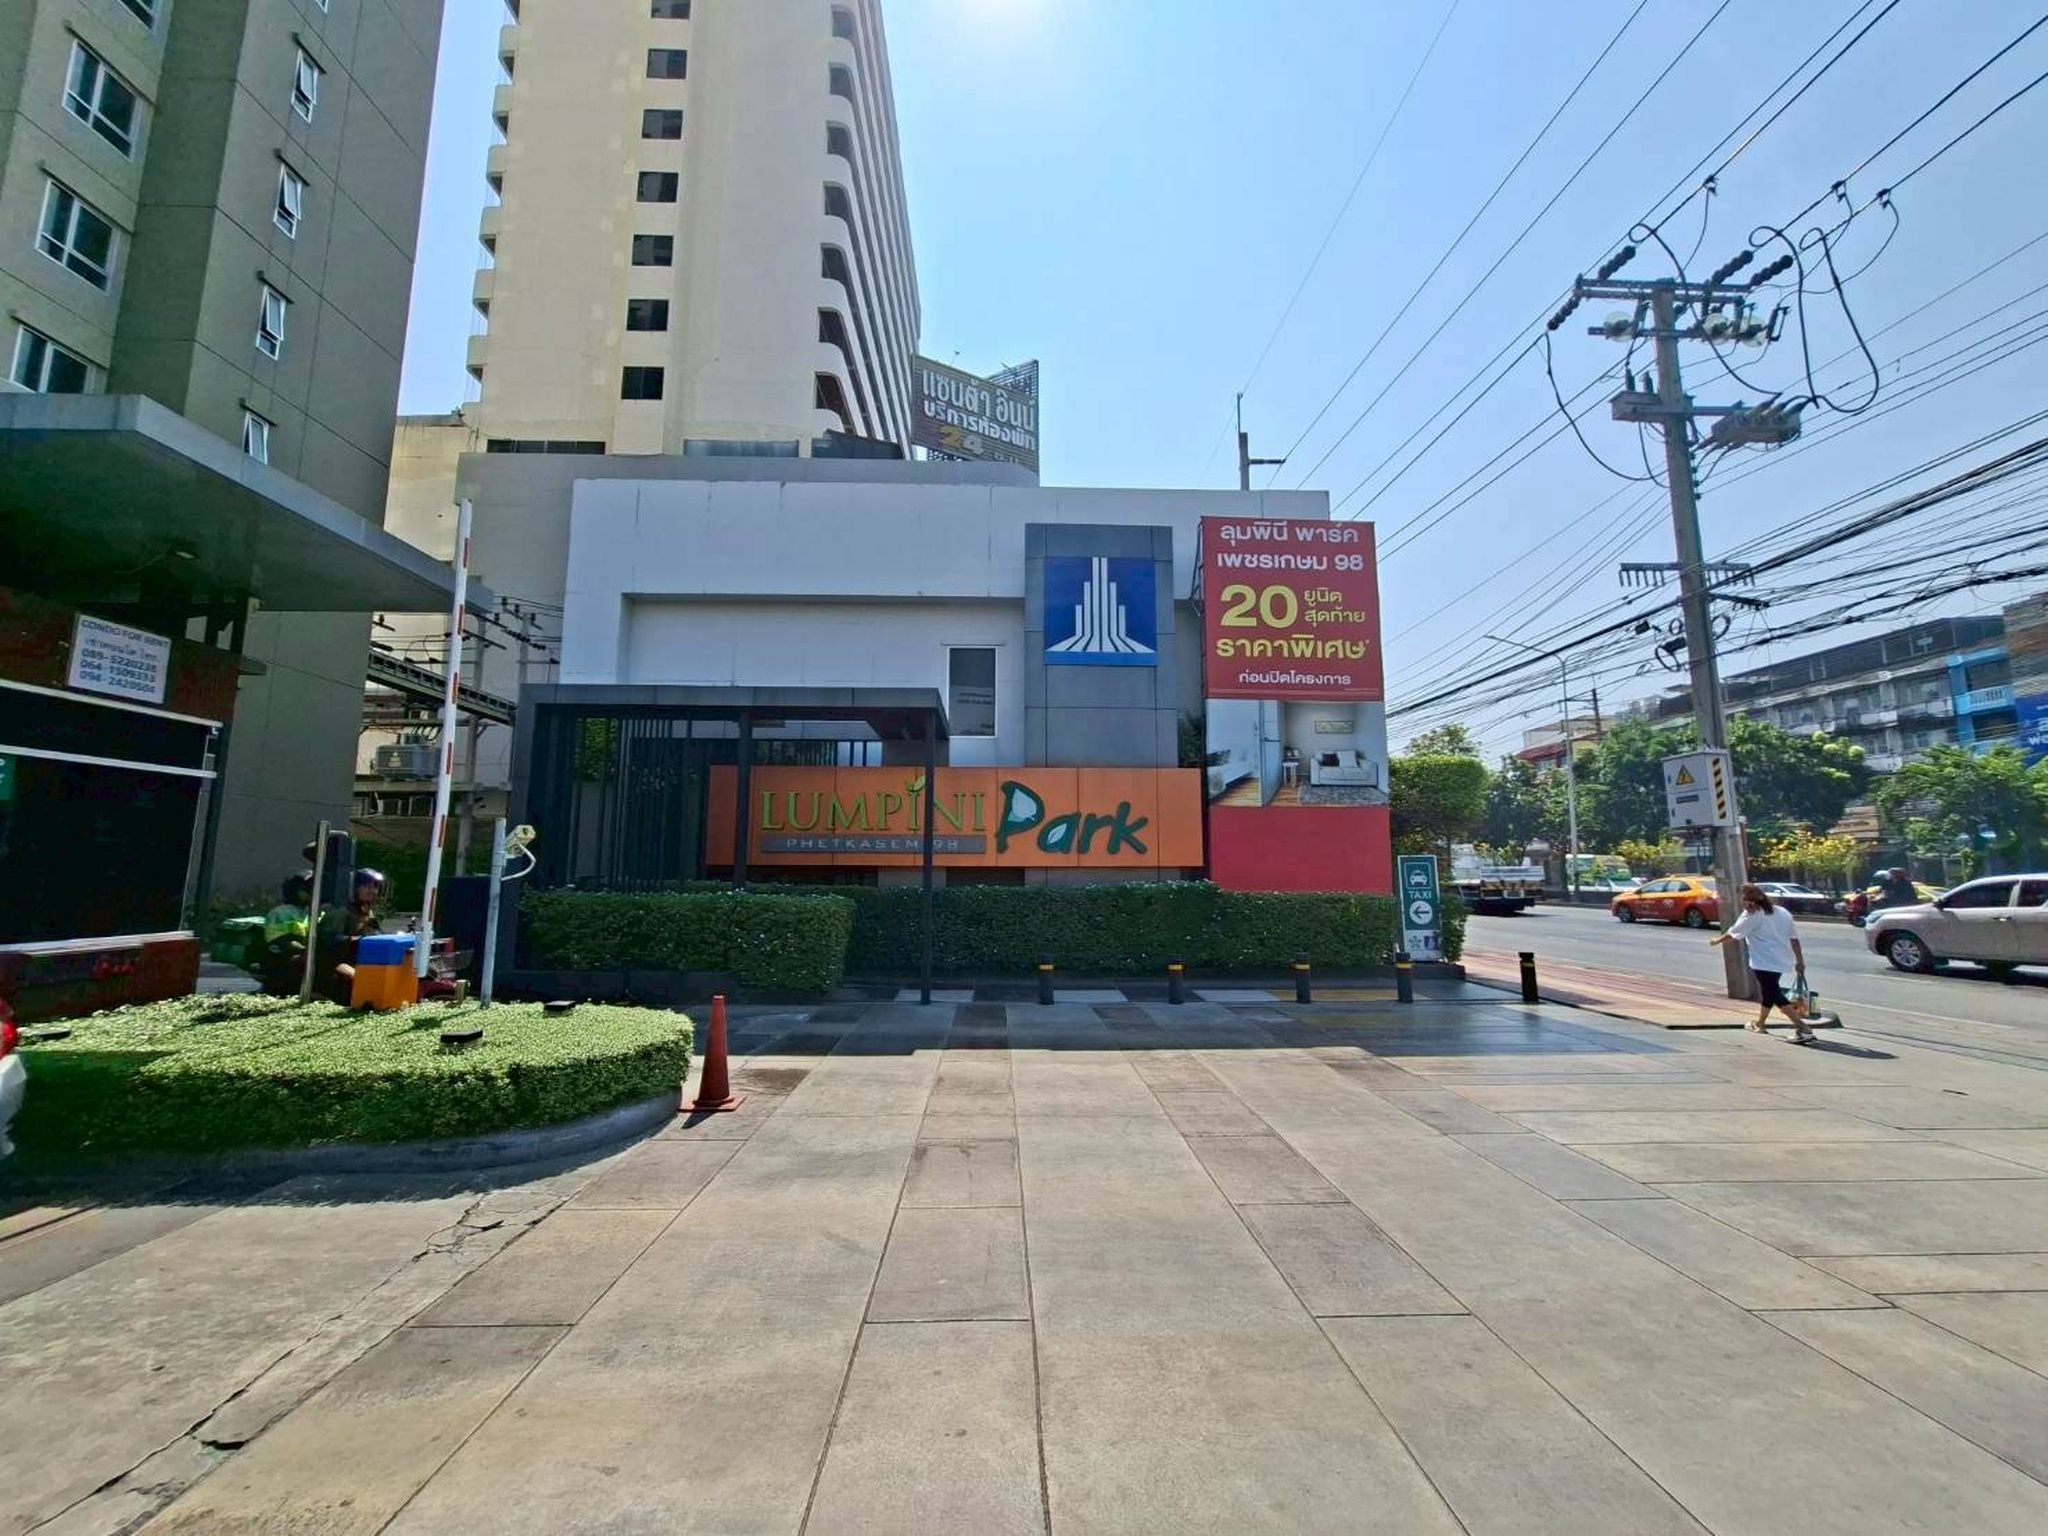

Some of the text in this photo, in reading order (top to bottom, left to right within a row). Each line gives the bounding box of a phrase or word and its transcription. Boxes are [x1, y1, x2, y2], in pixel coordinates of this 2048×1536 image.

[1220, 521, 1359, 546] ลุมพินี พาร์ค
[1217, 553, 1364, 571] เพชรเกษม 98
[1220, 584, 1298, 629] 20
[1304, 588, 1342, 607] ยูนิต
[1304, 605, 1365, 627] สุดท้าย
[1239, 669, 1351, 685] ก่อนปิดโครงการ
[760, 780, 1149, 855] LUMPINI Park
[786, 838, 960, 850] PHETKASEM 98
[1408, 890, 1432, 899] TAXI
